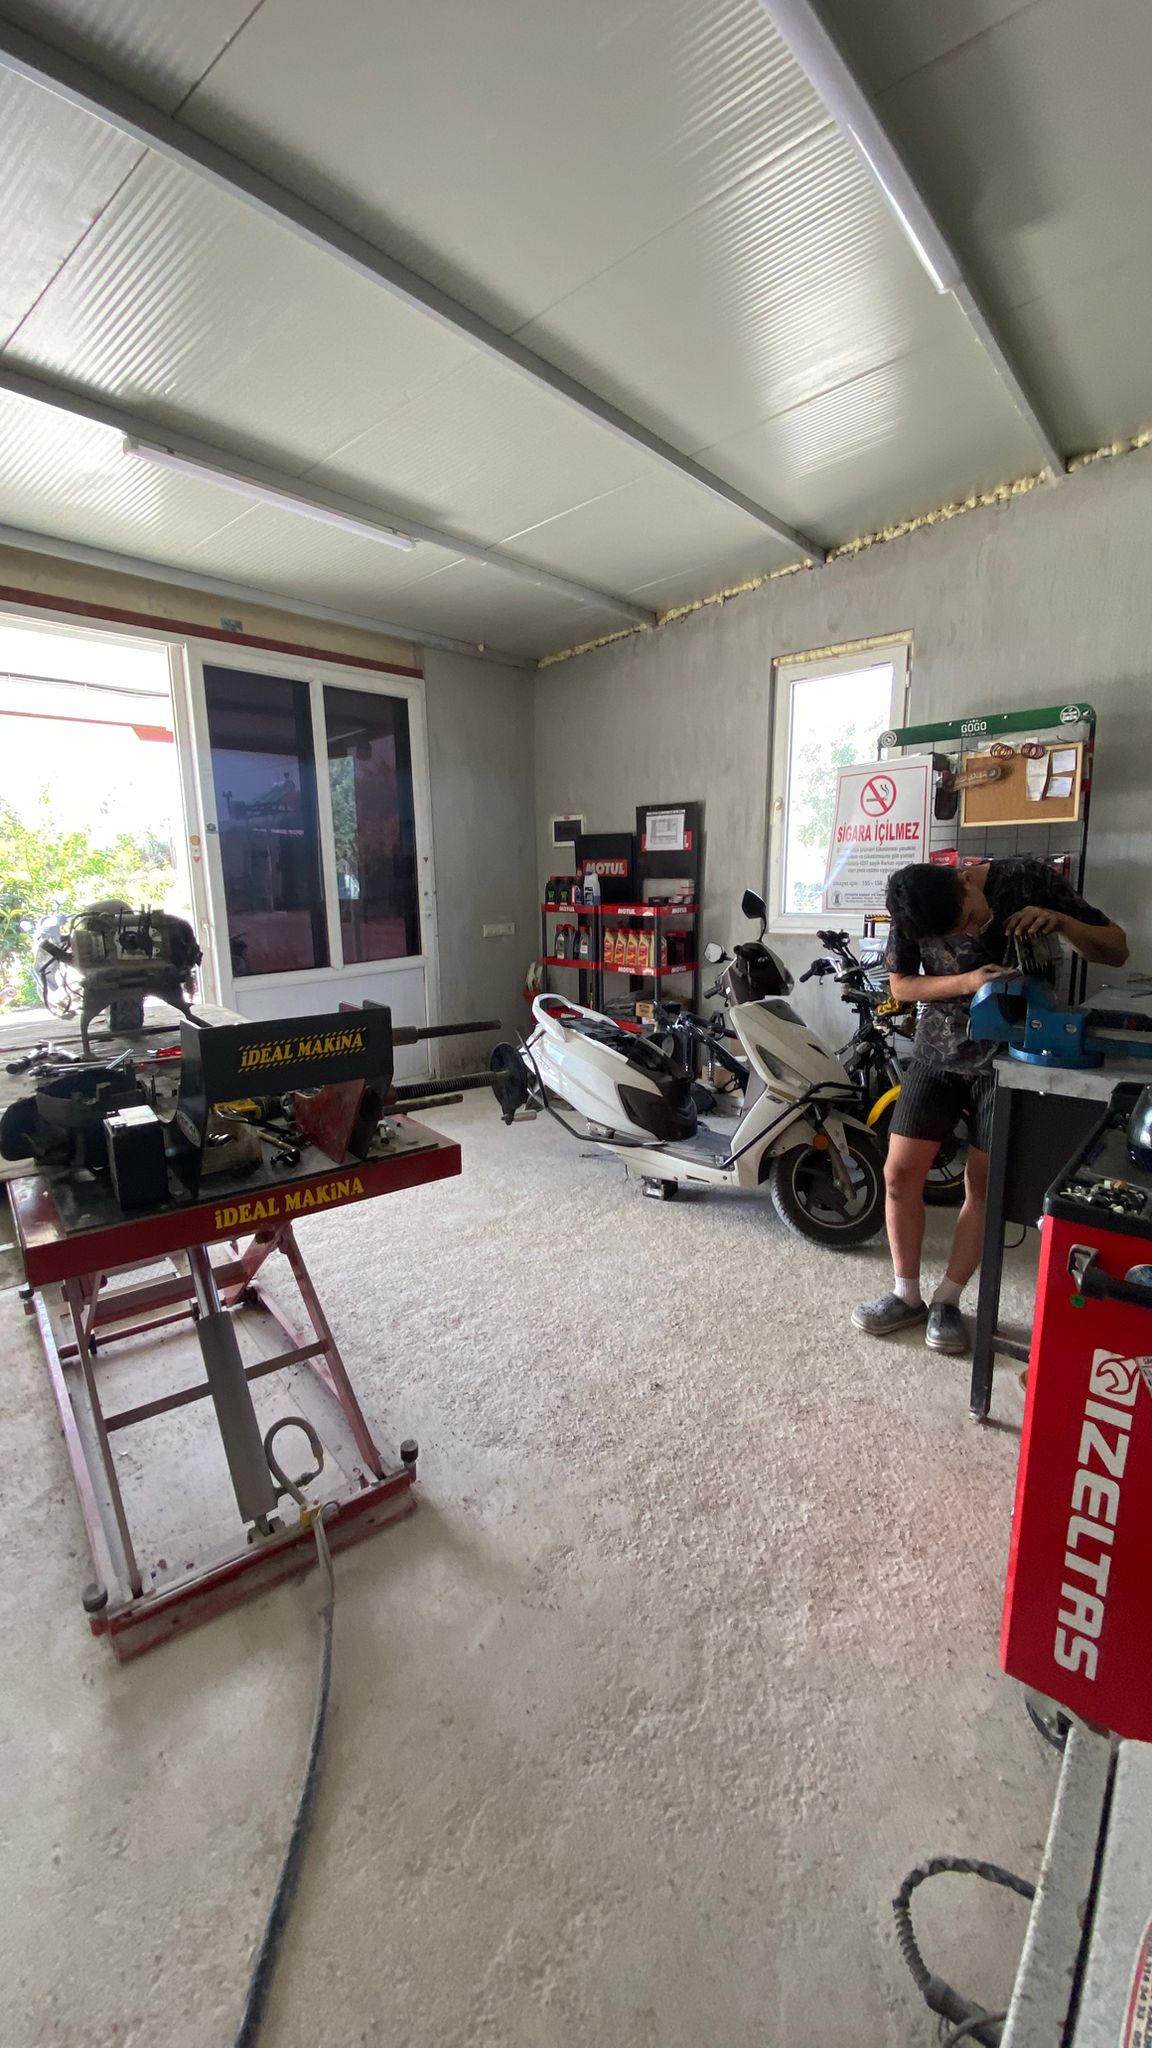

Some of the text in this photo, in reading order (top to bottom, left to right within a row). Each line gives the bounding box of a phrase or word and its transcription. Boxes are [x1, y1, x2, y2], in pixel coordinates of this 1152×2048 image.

[961, 721, 987, 733] GOGO
[837, 819, 920, 846] SİGARA İÇİLMEZ
[585, 862, 625, 875] MOTUL
[617, 966, 636, 974] MOTUL
